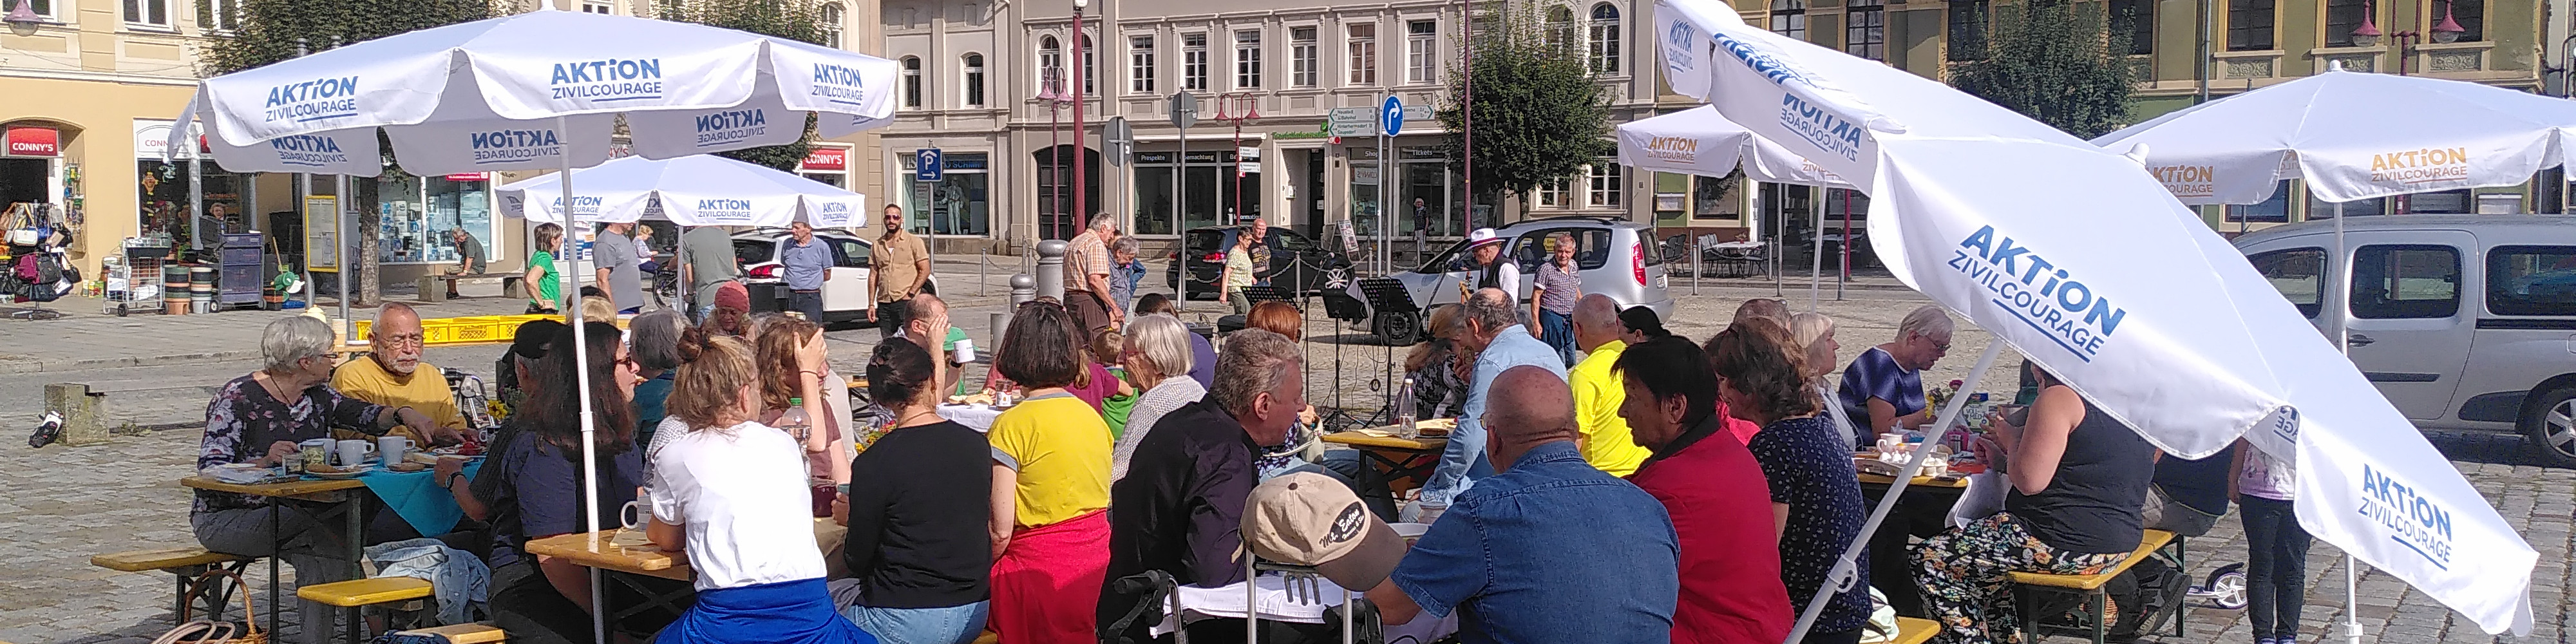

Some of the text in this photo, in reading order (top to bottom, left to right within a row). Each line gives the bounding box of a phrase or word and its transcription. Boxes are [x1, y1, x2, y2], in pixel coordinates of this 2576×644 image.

[552, 82, 661, 99] ZIVILCOURAGE
[811, 84, 863, 101] ZIVILCOURAGE
[265, 98, 357, 122] ZIVILCOURAGE
[12, 142, 53, 152] CONNY'S
[1647, 151, 1695, 160] ZIVILCOURAGE
[2372, 166, 2467, 182] ZIVILCOURAGE
[1947, 249, 2105, 355] ZIVILCOURAGE
[1338, 509, 1359, 533] Eaton
[2358, 496, 2452, 564] ZIVILCOURAGE
